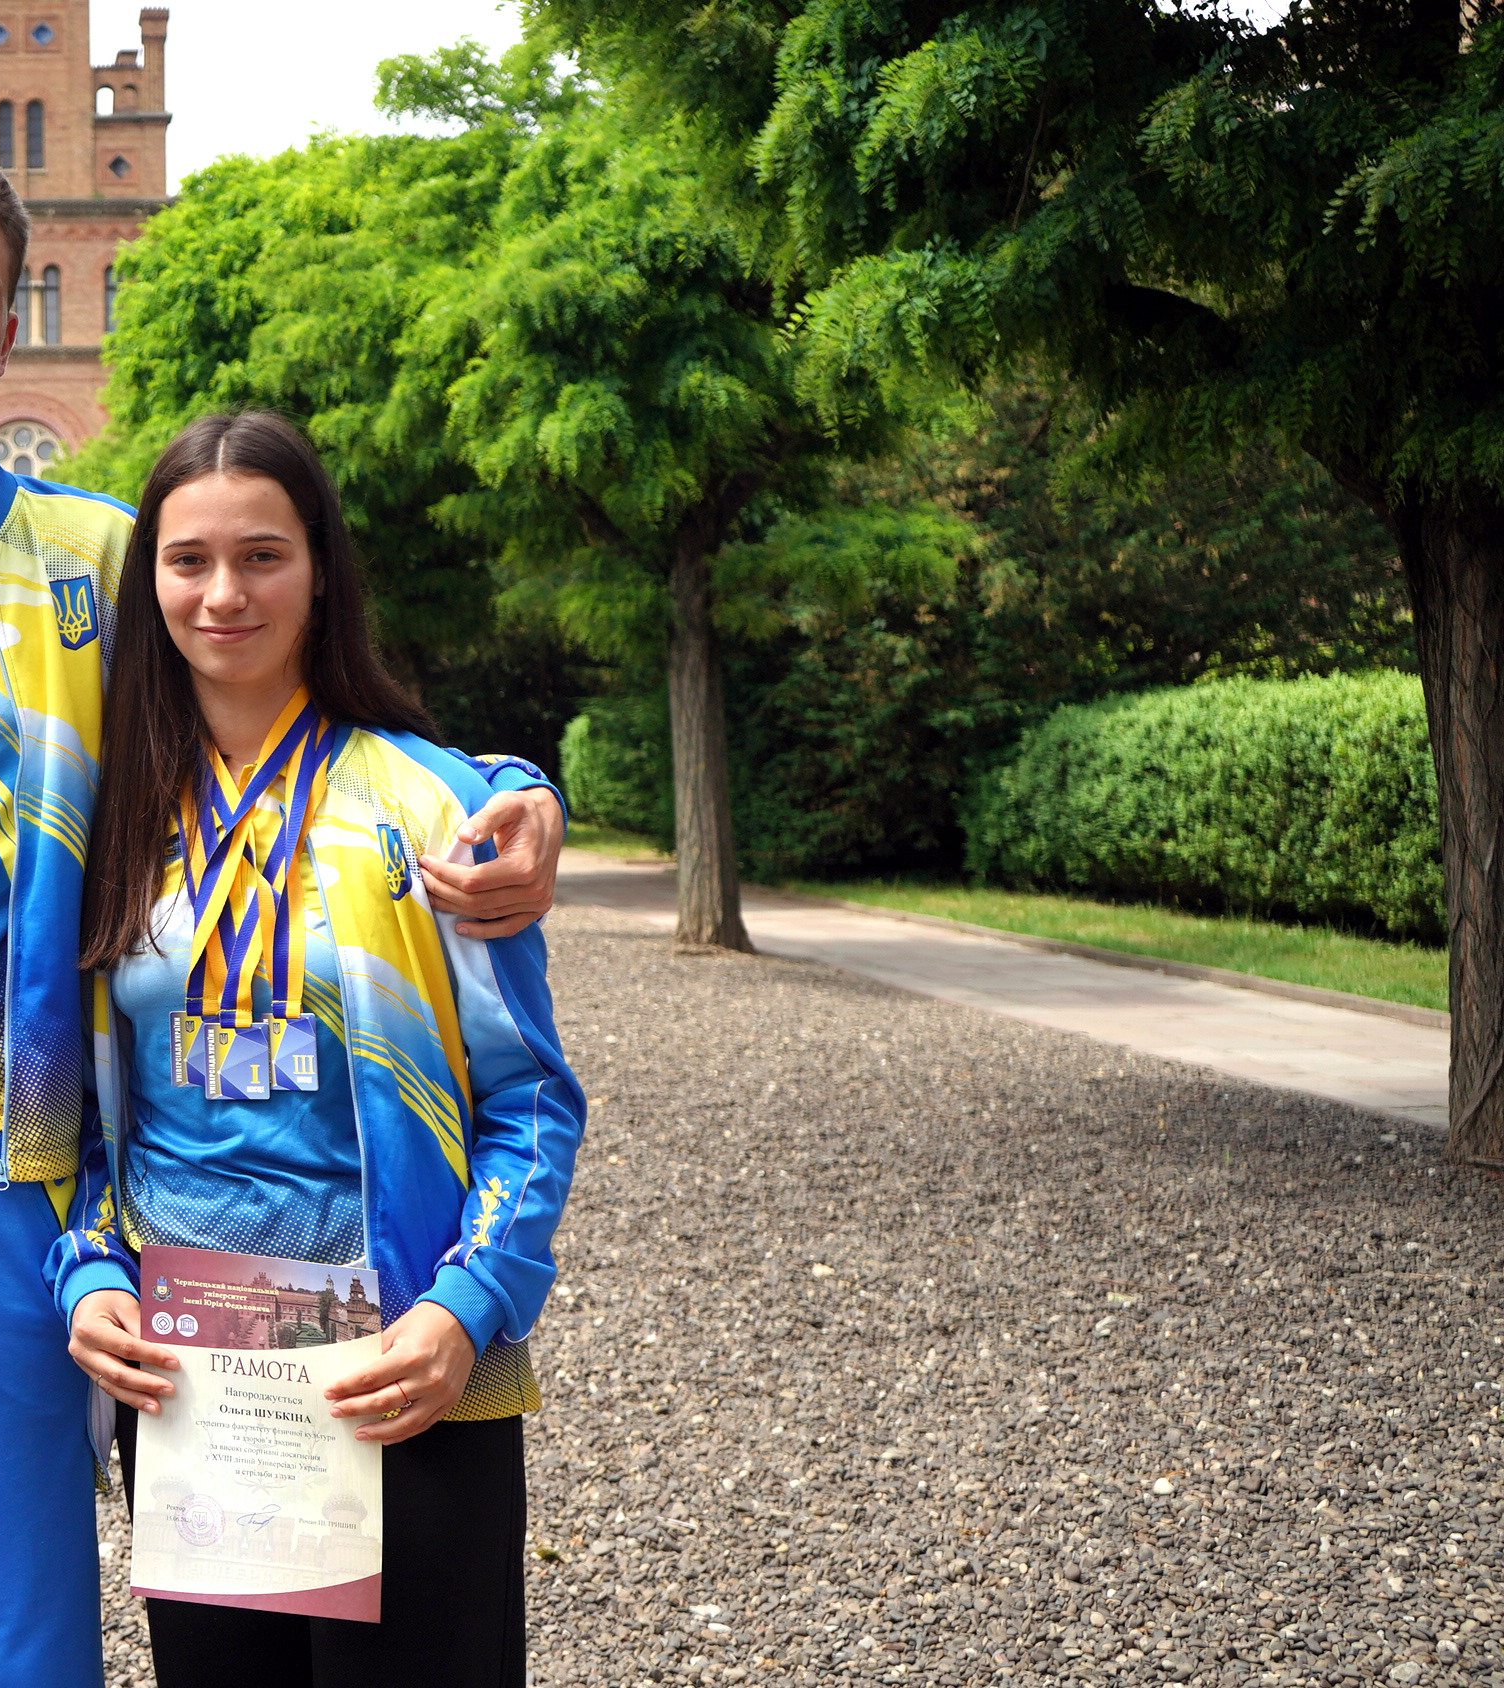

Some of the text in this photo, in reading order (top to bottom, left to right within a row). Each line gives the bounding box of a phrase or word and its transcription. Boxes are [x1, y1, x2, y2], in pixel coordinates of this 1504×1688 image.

[292, 1054, 316, 1074] III
[174, 1278, 280, 1296] Чернівецький національний
[204, 1291, 248, 1300] університет
[204, 1299, 223, 1308] Юрія
[224, 1302, 270, 1312] Федьковича
[210, 1354, 312, 1384] ГРАМОТА
[225, 1387, 303, 1406] Нагороджується
[219, 1404, 312, 1424] Ольга ШУБКІНА
[196, 1420, 230, 1428] студентка
[232, 1422, 271, 1434] факультету
[304, 1432, 336, 1443] культури
[220, 1444, 242, 1452] високі
[212, 1453, 232, 1463] XVIII
[298, 1462, 328, 1473] України
[242, 1469, 273, 1479] стрільби
[166, 1504, 186, 1512] Ректор
[298, 1518, 318, 1526] Роман
